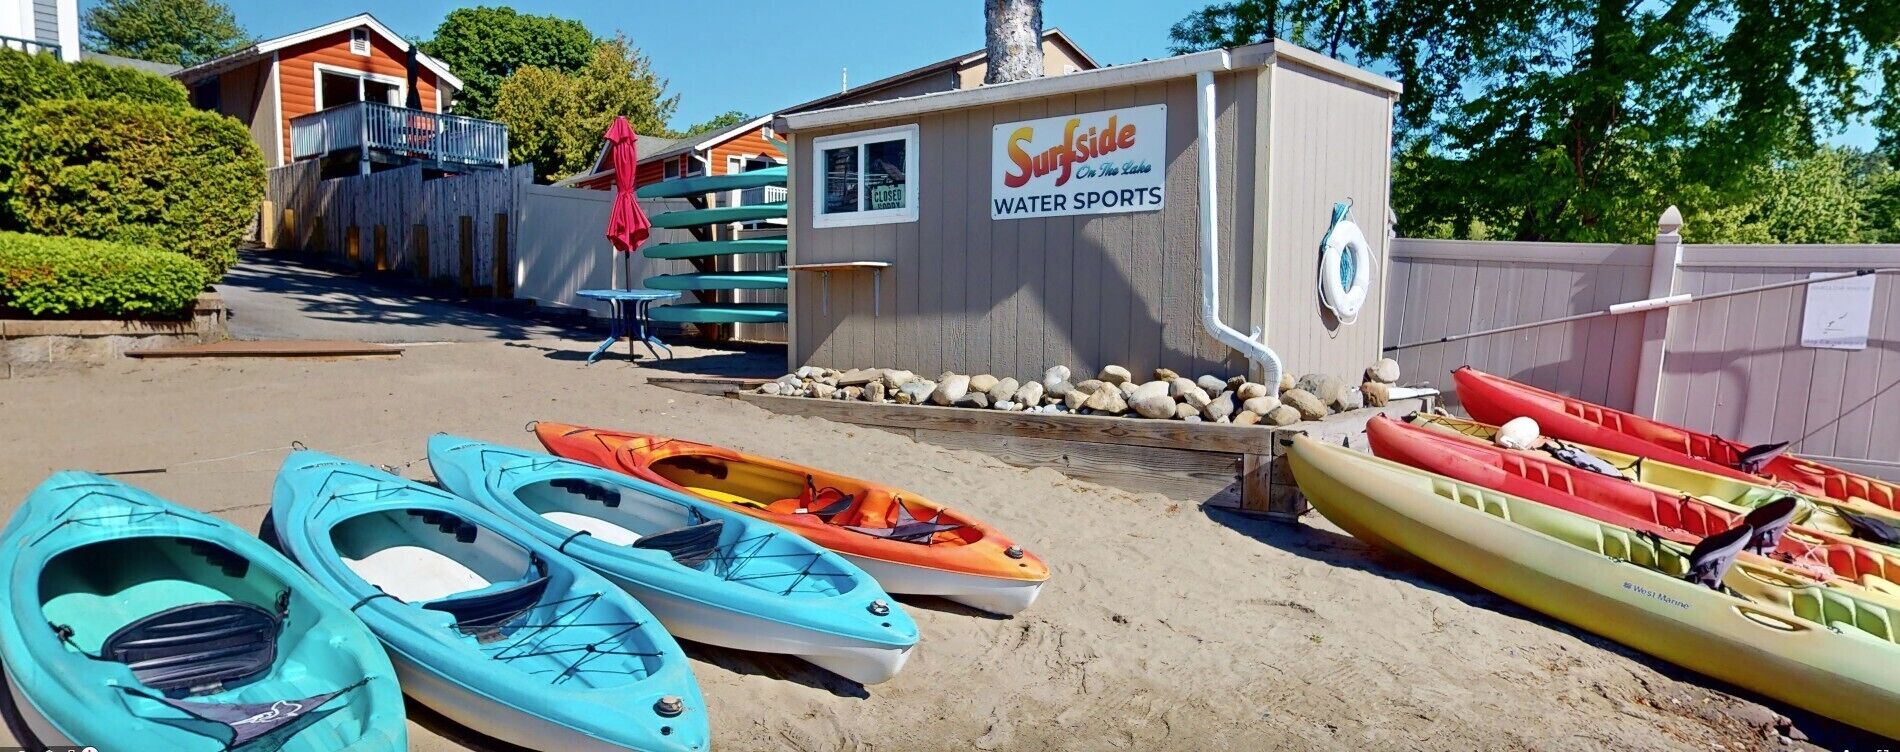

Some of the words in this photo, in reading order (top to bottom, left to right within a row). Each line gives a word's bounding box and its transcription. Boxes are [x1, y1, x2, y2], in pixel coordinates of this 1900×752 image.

[1004, 115, 1136, 188] Surfside
[1076, 165, 1096, 179] On
[1098, 162, 1119, 178] The
[1121, 160, 1152, 176] Lake
[874, 189, 902, 203] CLOSED
[994, 194, 1067, 215] WATER
[1073, 186, 1162, 210] SPORTS
[1633, 585, 1656, 599] West
[1657, 593, 1689, 610] Marine
